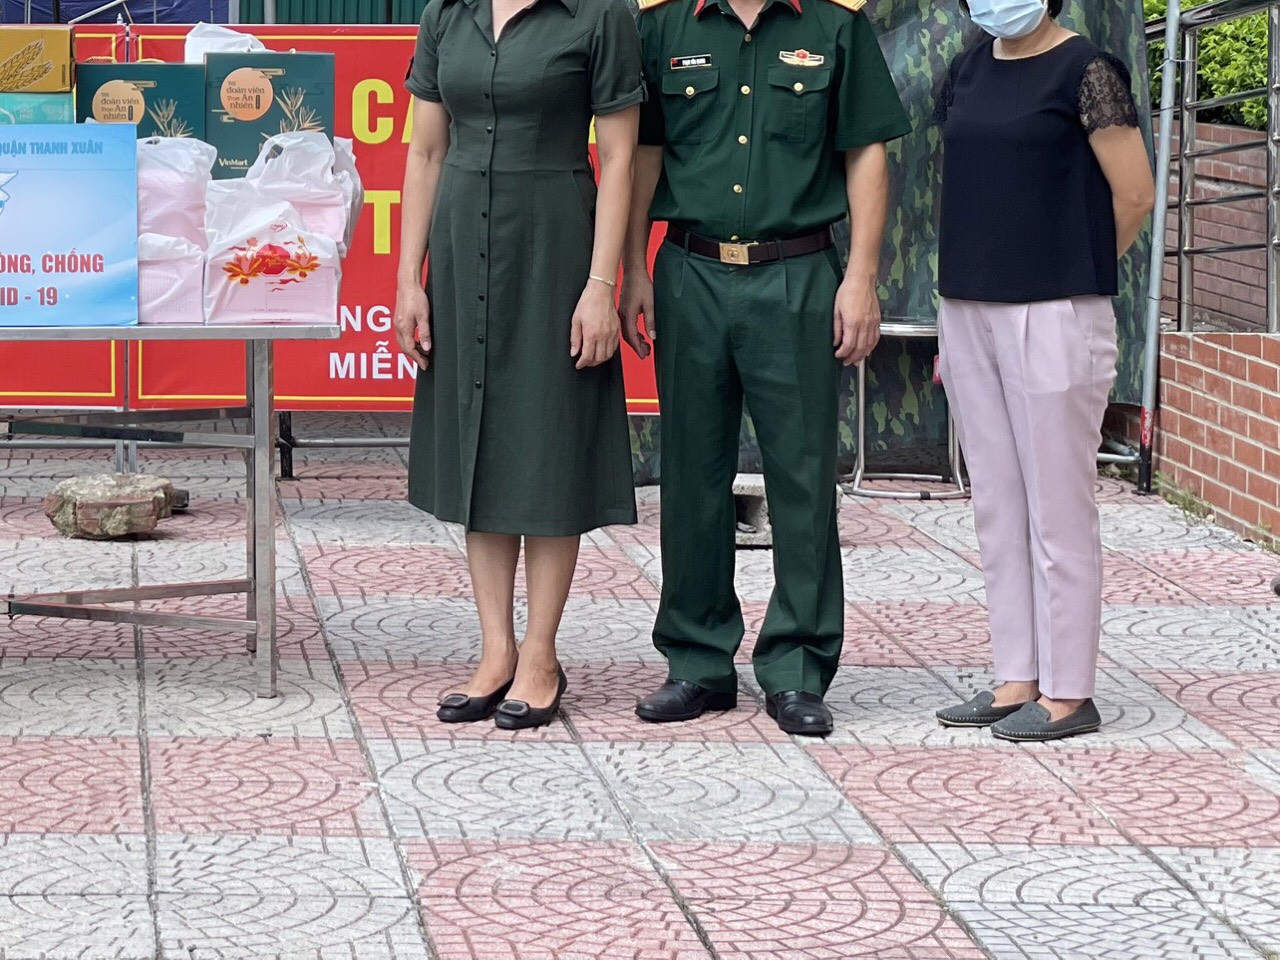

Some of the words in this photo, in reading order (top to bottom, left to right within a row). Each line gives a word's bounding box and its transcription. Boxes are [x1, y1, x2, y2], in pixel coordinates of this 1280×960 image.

[226, 86, 246, 94] đoàn
[247, 86, 265, 94] viên
[101, 97, 121, 105] đoàn
[122, 97, 139, 105] viên
[230, 101, 253, 109] nhiên
[103, 112, 127, 120] nhiên
[29, 141, 68, 155] THANH
[71, 139, 103, 155] XUÂN
[218, 157, 248, 167] VinMart
[41, 248, 105, 274] CHỐNG
[36, 287, 59, 306] 19
[329, 340, 418, 379] MIỄN
